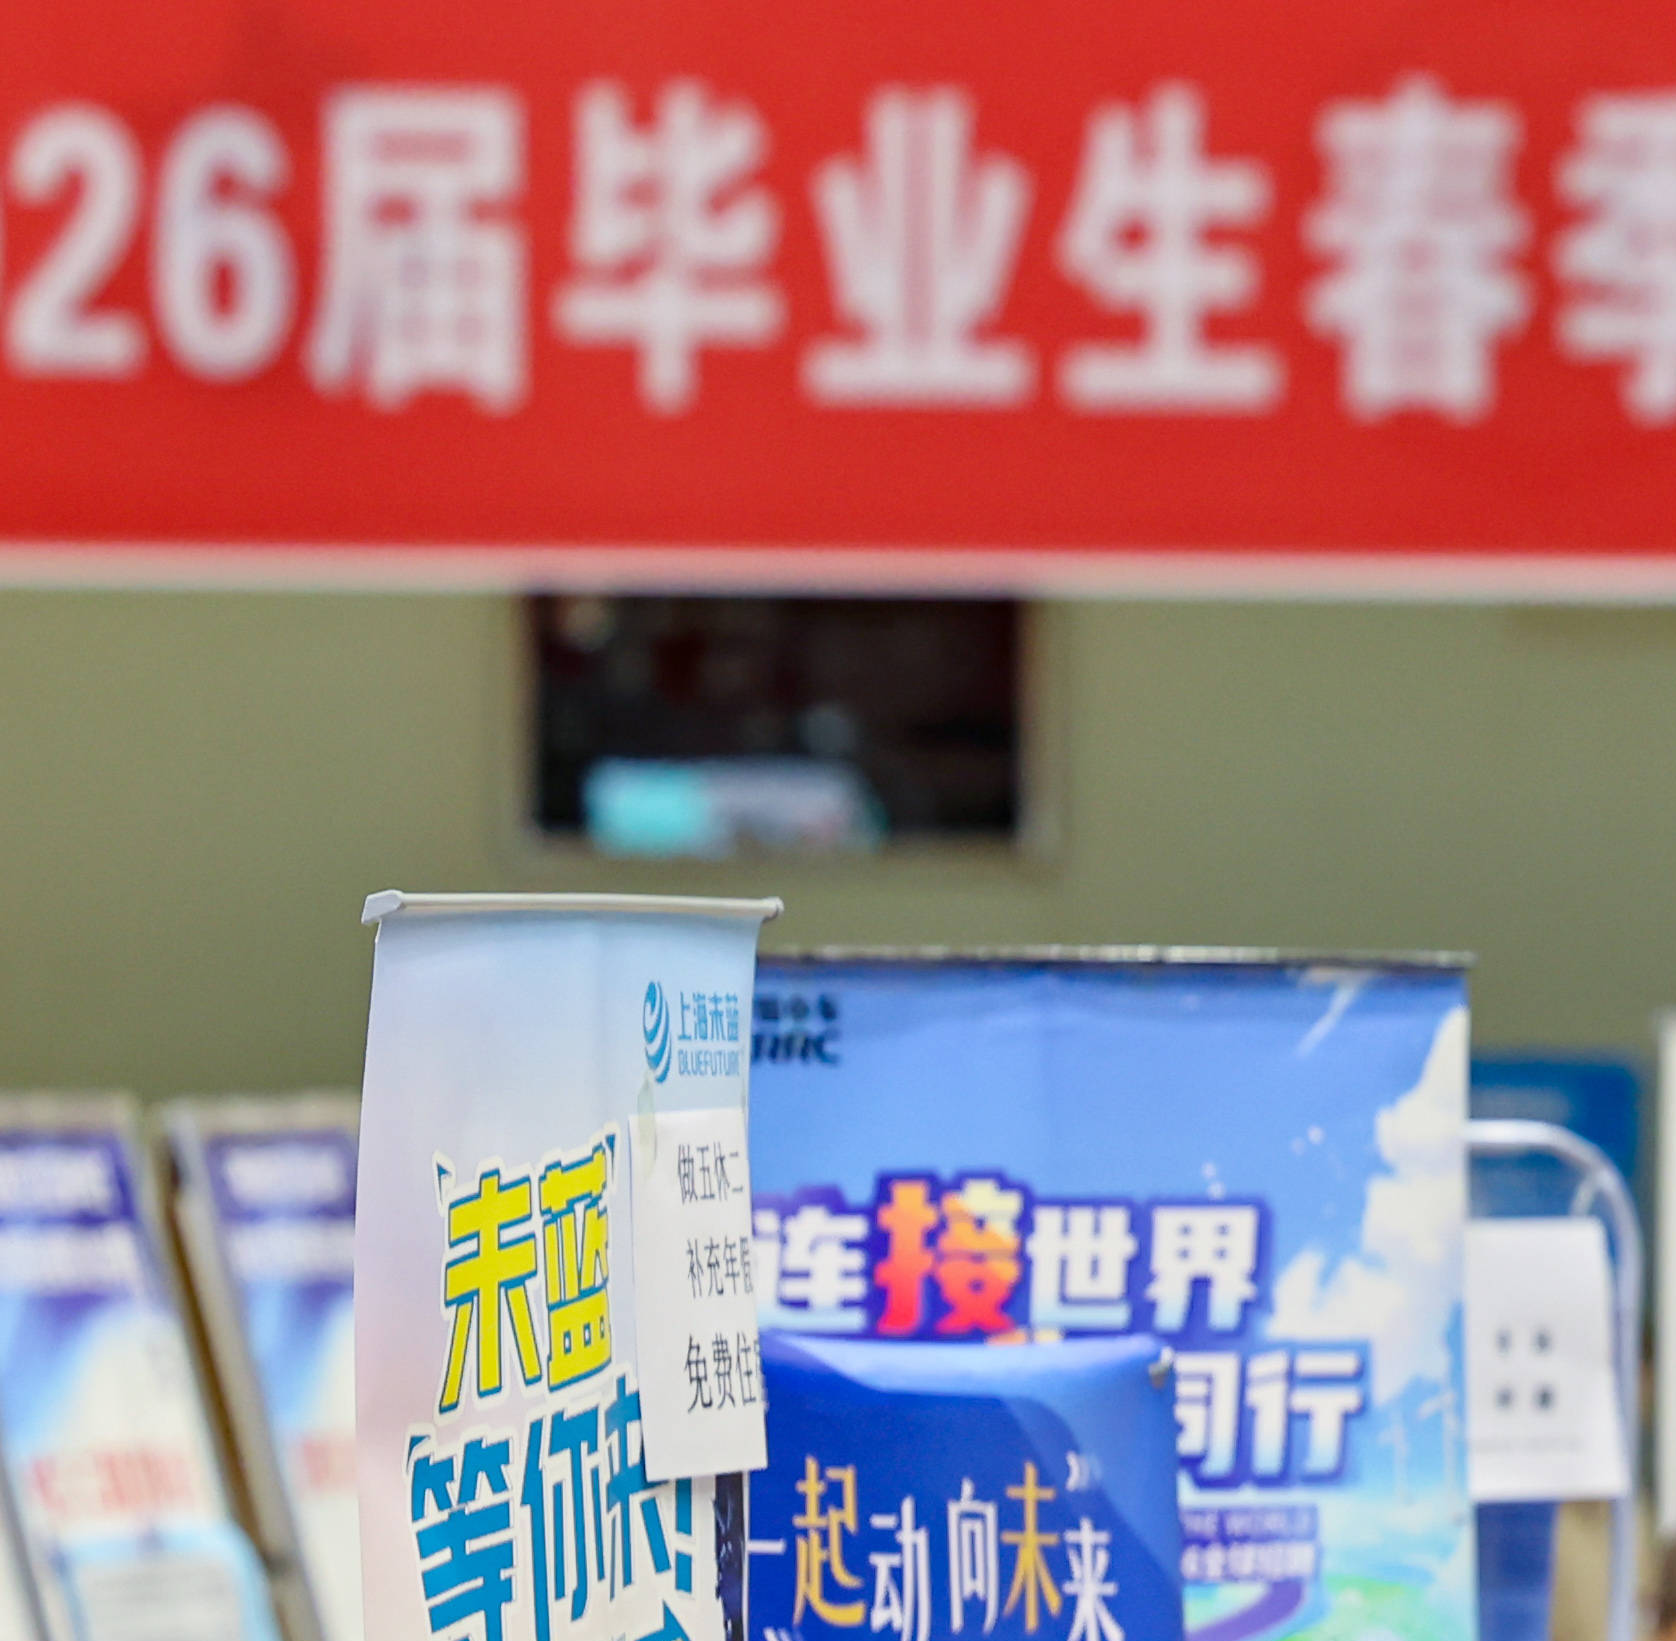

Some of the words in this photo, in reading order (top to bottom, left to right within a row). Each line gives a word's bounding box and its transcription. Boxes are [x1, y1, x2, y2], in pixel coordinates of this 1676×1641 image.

[678, 1142, 744, 1203] 做五休二
[438, 1145, 612, 1414] 未蓝
[753, 1178, 1259, 1334] 连接世界
